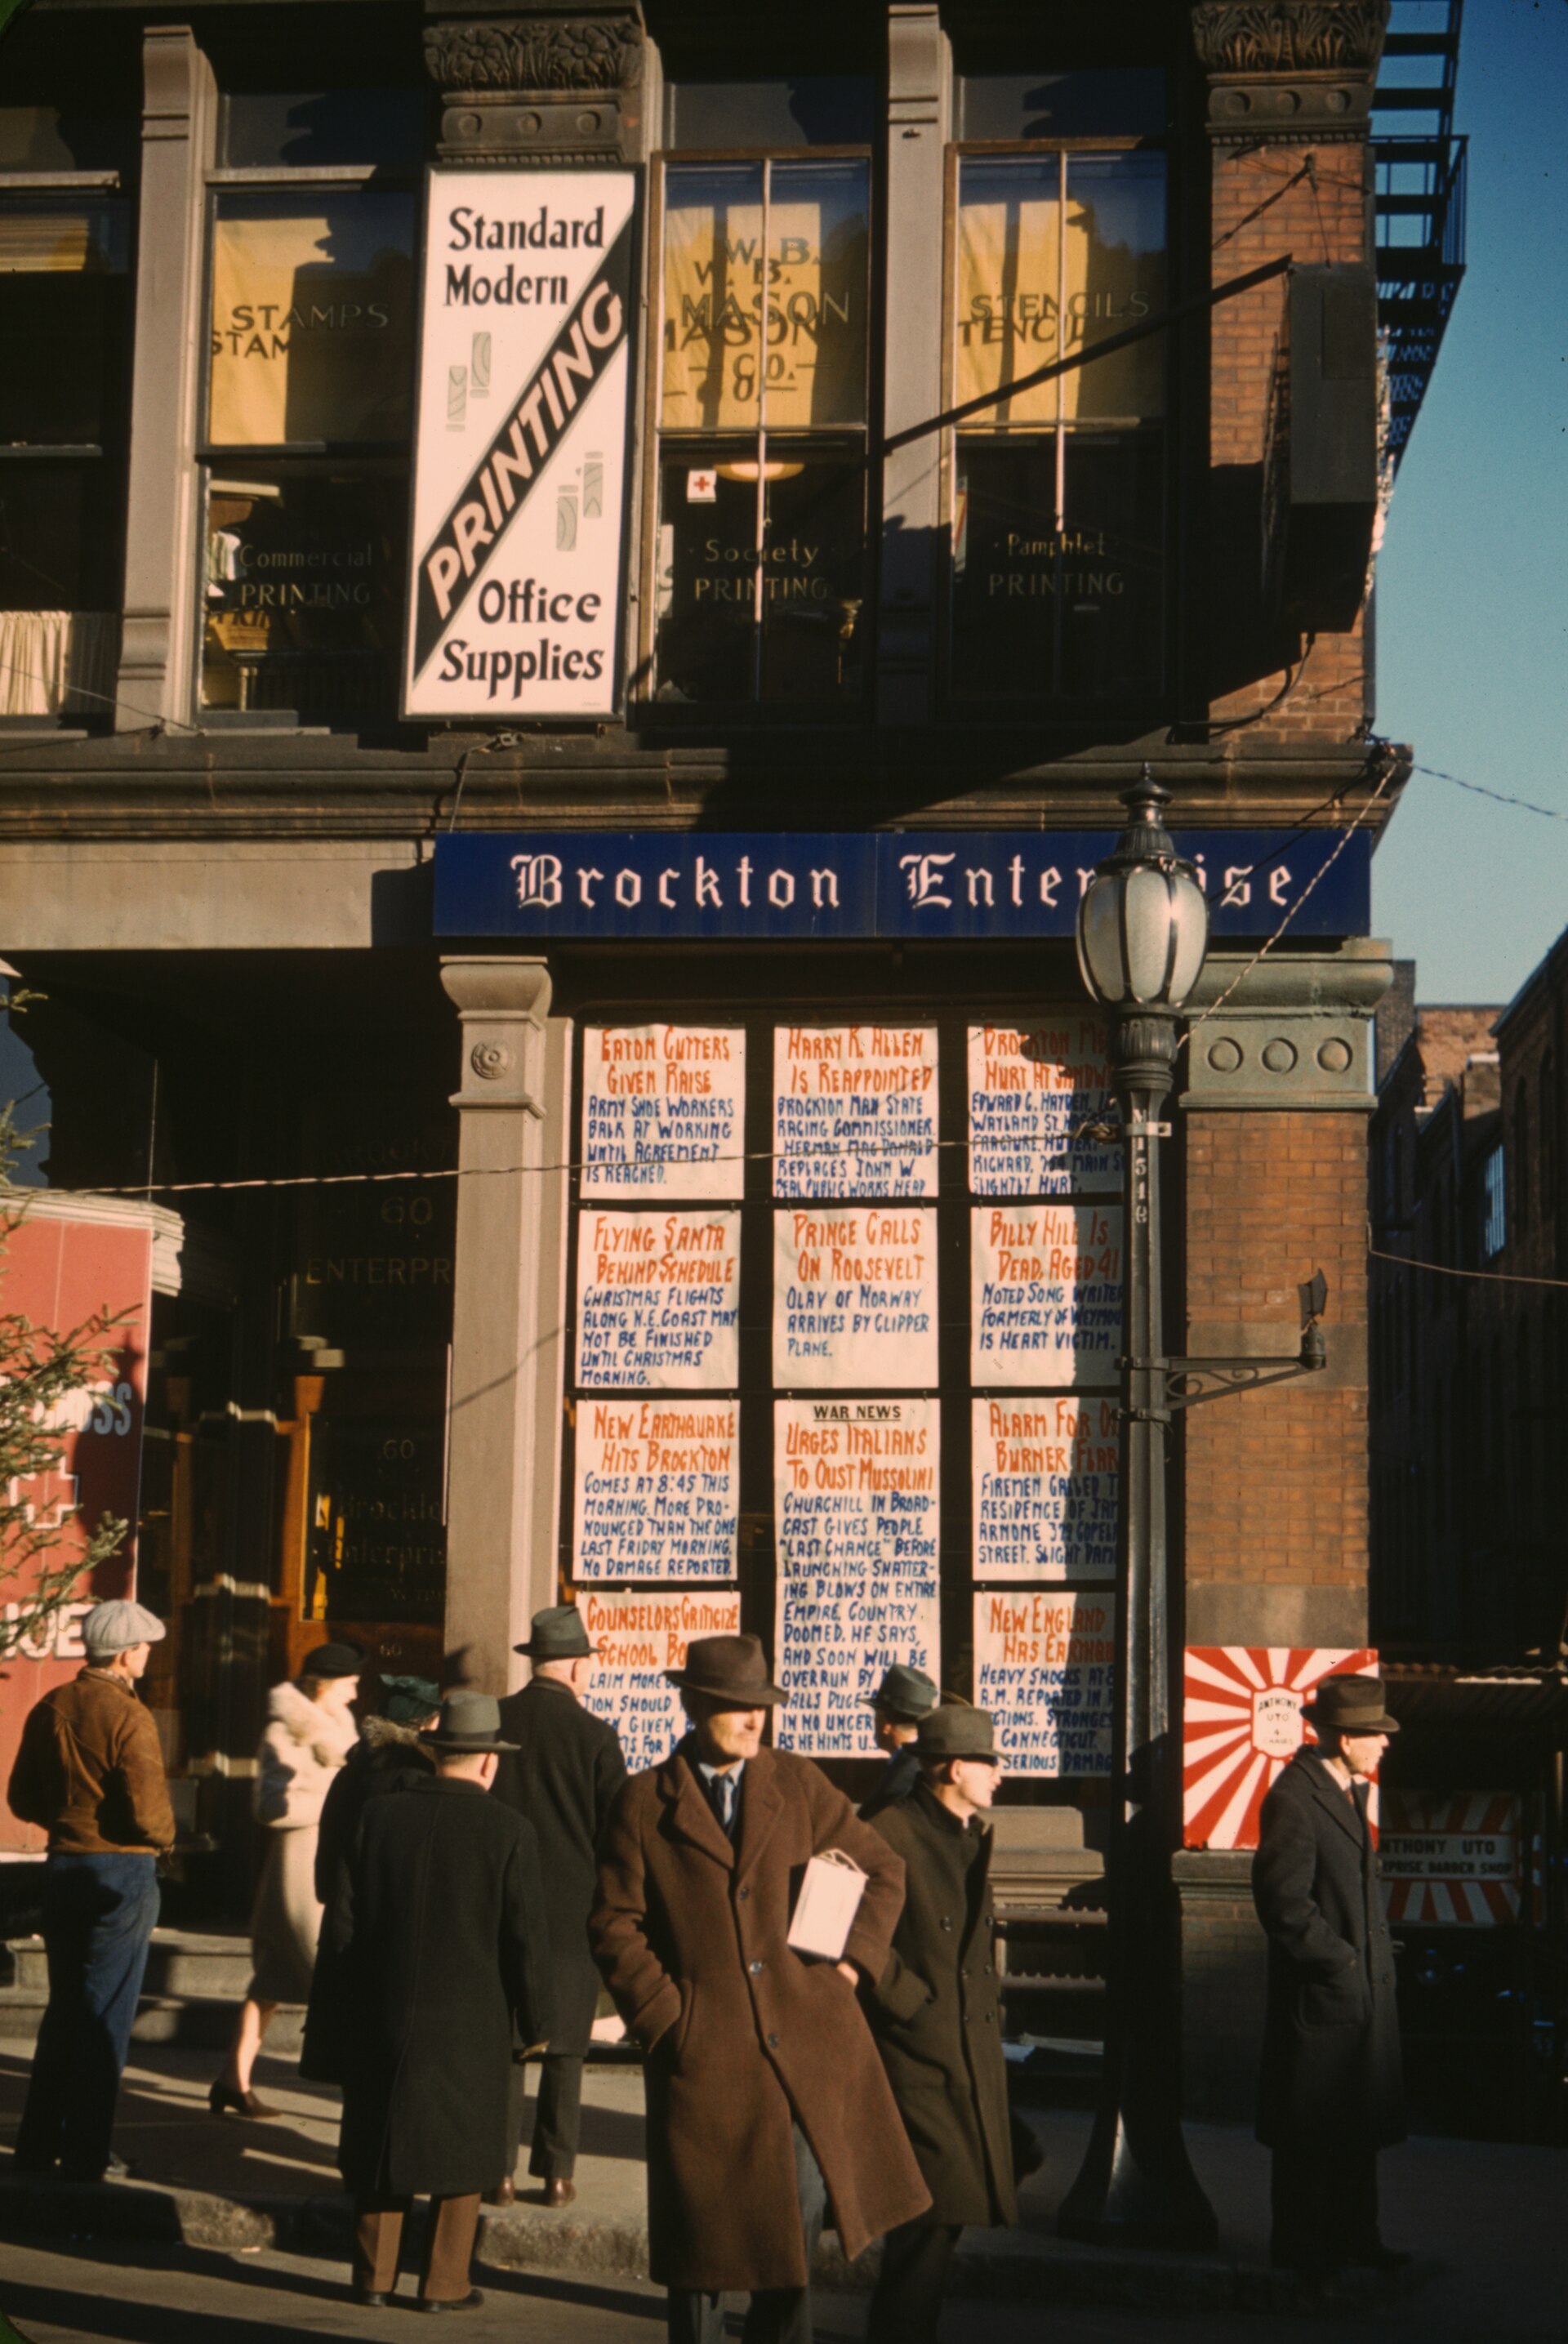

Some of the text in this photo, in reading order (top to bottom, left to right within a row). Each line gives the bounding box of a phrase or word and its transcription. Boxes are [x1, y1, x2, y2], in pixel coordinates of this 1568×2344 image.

[448, 206, 604, 250] Standard
[780, 238, 820, 265] B.
[444, 265, 568, 306] Modern
[232, 303, 390, 331] STAMPS
[681, 292, 850, 328] MASON
[970, 291, 1149, 322] STENCILS
[426, 281, 623, 618] PRINTING
[240, 542, 372, 568] Commercial
[705, 537, 819, 568] Society
[242, 582, 371, 608] PRINTING
[694, 577, 828, 602] PRINTING
[989, 573, 1125, 596] PRINTING
[479, 578, 602, 624] Office
[438, 639, 604, 700] Supplies
[510, 854, 840, 909] Brockton
[380, 1196, 434, 1226] 60
[305, 1257, 452, 1286] ENTERPR
[814, 1406, 901, 1419] WAR NEWS
[382, 1438, 415, 1459] 60
[1258, 1697, 1297, 1713] ANTHONY
[1267, 1713, 1290, 1722] UTO
[1462, 1839, 1495, 1856] UTO
[1428, 1861, 1512, 1875] BARBER SHOP
